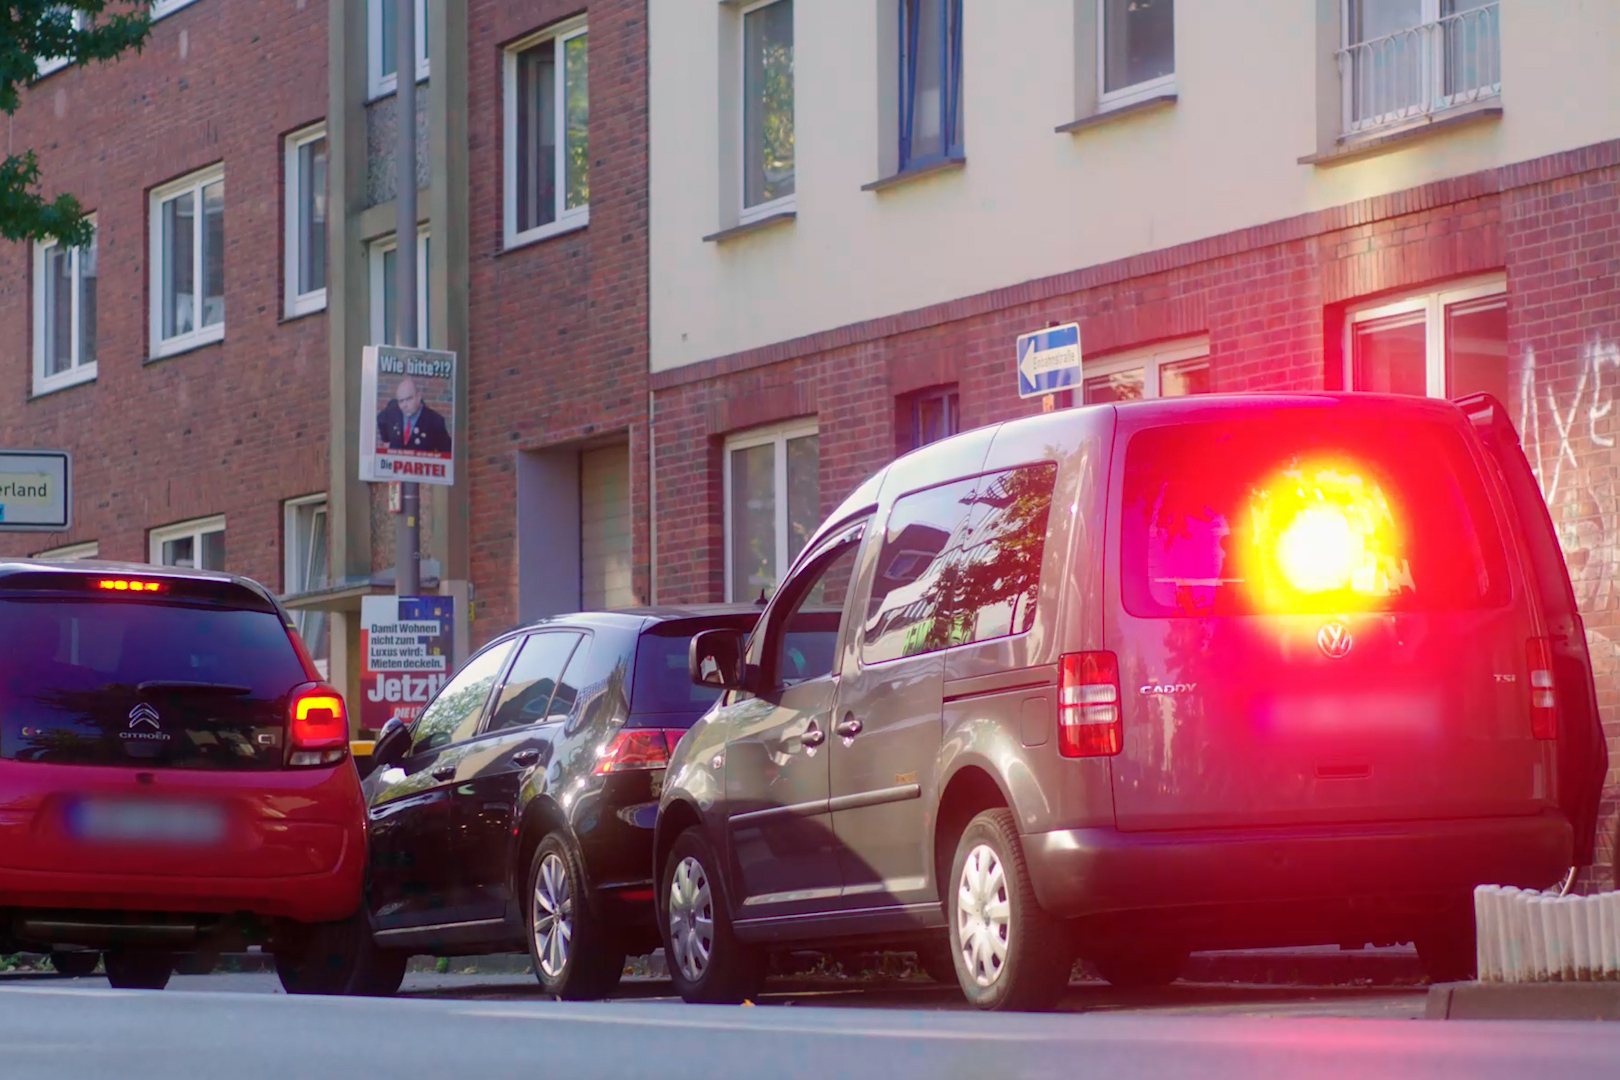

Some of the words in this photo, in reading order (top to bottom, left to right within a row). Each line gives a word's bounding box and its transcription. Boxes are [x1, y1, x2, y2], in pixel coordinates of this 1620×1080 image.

[380, 355, 404, 374] Wie
[407, 358, 452, 378] bitte?!?
[380, 458, 392, 470] Die
[393, 461, 446, 477] PARTEI
[371, 623, 398, 634] Damit
[400, 624, 437, 634] Wohnen
[371, 635, 394, 645] nicht
[395, 637, 415, 645] zum
[371, 647, 398, 657] Luxus
[400, 648, 424, 657] wird:
[370, 658, 402, 669] Mieten
[403, 659, 443, 669] deckeln.
[1139, 682, 1198, 694] CADDY
[394, 706, 410, 718] DIE
